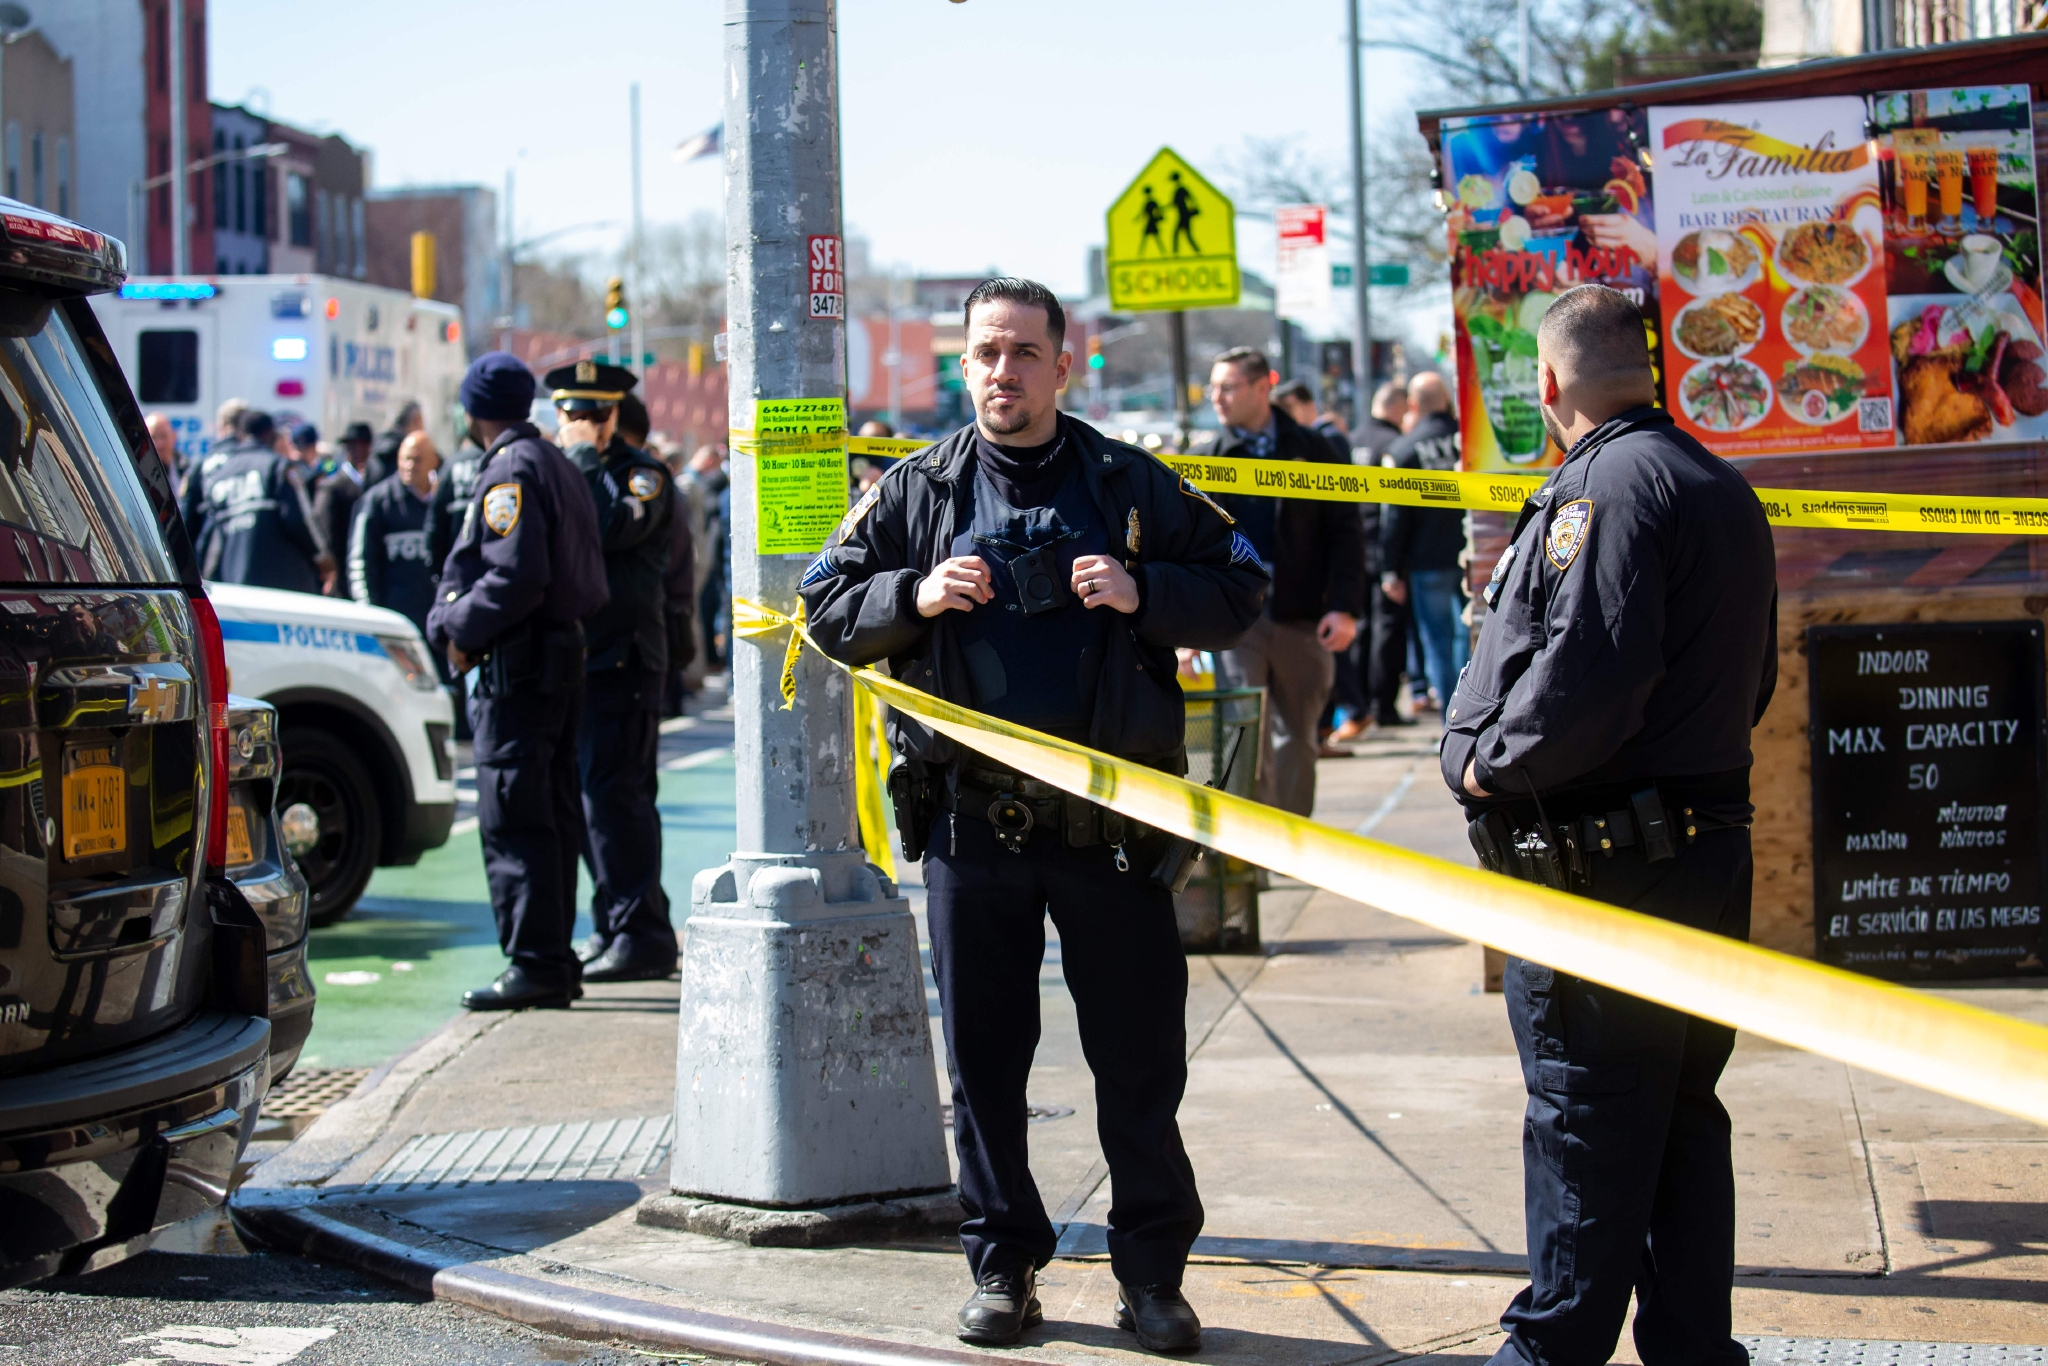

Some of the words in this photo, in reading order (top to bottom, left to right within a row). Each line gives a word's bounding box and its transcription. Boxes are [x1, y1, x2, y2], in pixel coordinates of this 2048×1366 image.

[1672, 138, 1709, 167] La
[1706, 130, 1852, 180] Familia
[1914, 153, 1959, 166] Fresh
[1691, 191, 1719, 204] Latin
[1733, 187, 1789, 202] Caribbean
[1791, 185, 1832, 199] Cuisine
[1679, 212, 1716, 228] BAR
[1722, 204, 1848, 227] RESTAURANT
[1465, 245, 1556, 293] happy
[1564, 240, 1640, 281] hour
[1118, 266, 1228, 295] SCHOOL
[762, 460, 771, 470] 30
[772, 460, 788, 469] Hour
[792, 459, 800, 469] 10
[801, 459, 815, 468] Hour
[818, 458, 826, 468] 40
[1205, 464, 1237, 483] CRIME
[1255, 468, 1287, 489] (8477)
[1289, 471, 1370, 493] 1-800-577-TIPS
[1490, 485, 1525, 502] CROSS
[1919, 506, 1957, 523] CROSS
[1960, 508, 1982, 524] NOT
[1984, 509, 2000, 525] DO
[282, 624, 353, 652] POLICE
[1857, 649, 1930, 676] INDOOR
[1828, 726, 1886, 756] MAX
[1906, 719, 2019, 750] CAPACITY
[1908, 763, 1939, 790] 50
[1907, 876, 1932, 896] DE
[1829, 915, 1851, 937] EL
[1936, 908, 1956, 932] EN
[1959, 907, 1987, 930] LAS
[1990, 906, 2041, 928] MESAS
